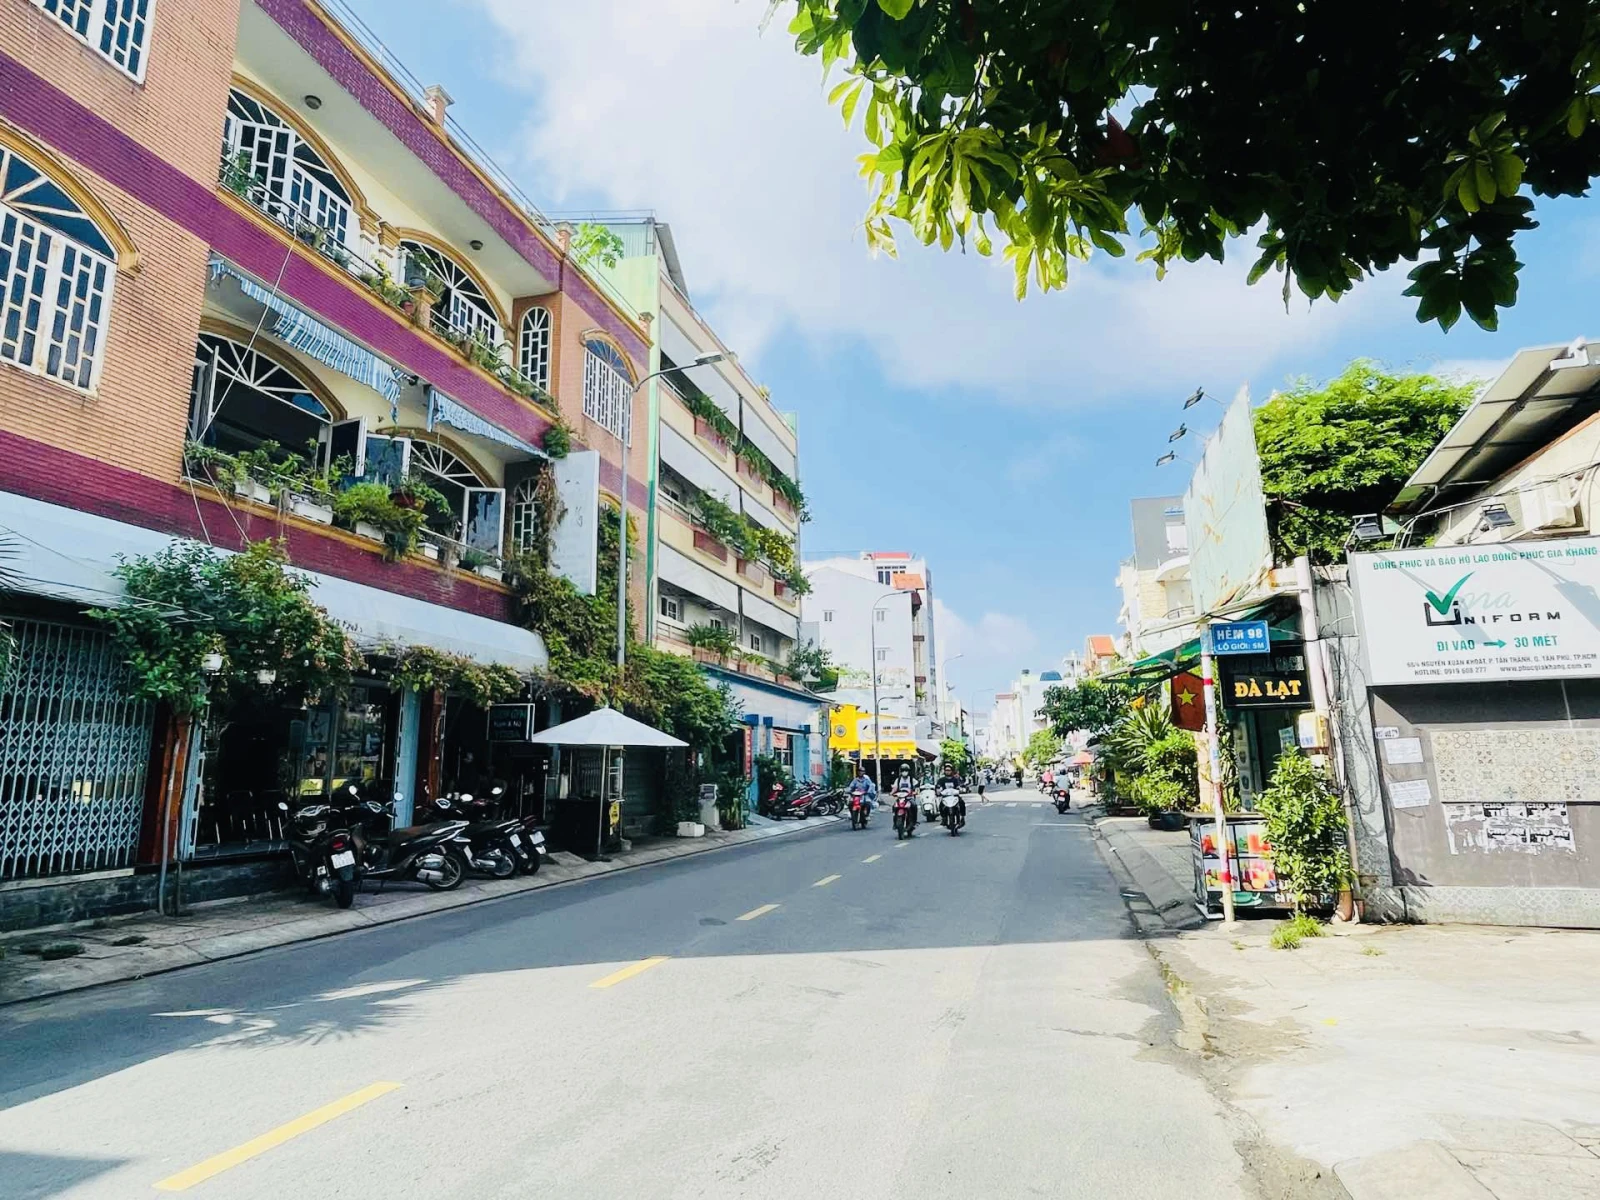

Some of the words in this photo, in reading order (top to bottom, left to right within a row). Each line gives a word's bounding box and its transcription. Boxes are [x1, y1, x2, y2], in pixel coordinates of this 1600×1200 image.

[1473, 553, 1490, 563] LAO
[1547, 549, 1563, 559] GIA
[1565, 546, 1597, 557] KHANG
[1216, 626, 1244, 640] HẺM
[1247, 628, 1263, 639] 98
[1437, 641, 1448, 652] ĐI
[1514, 637, 1529, 648] 30
[1234, 678, 1263, 698] ĐÀ
[1265, 679, 1302, 700] LẠT
